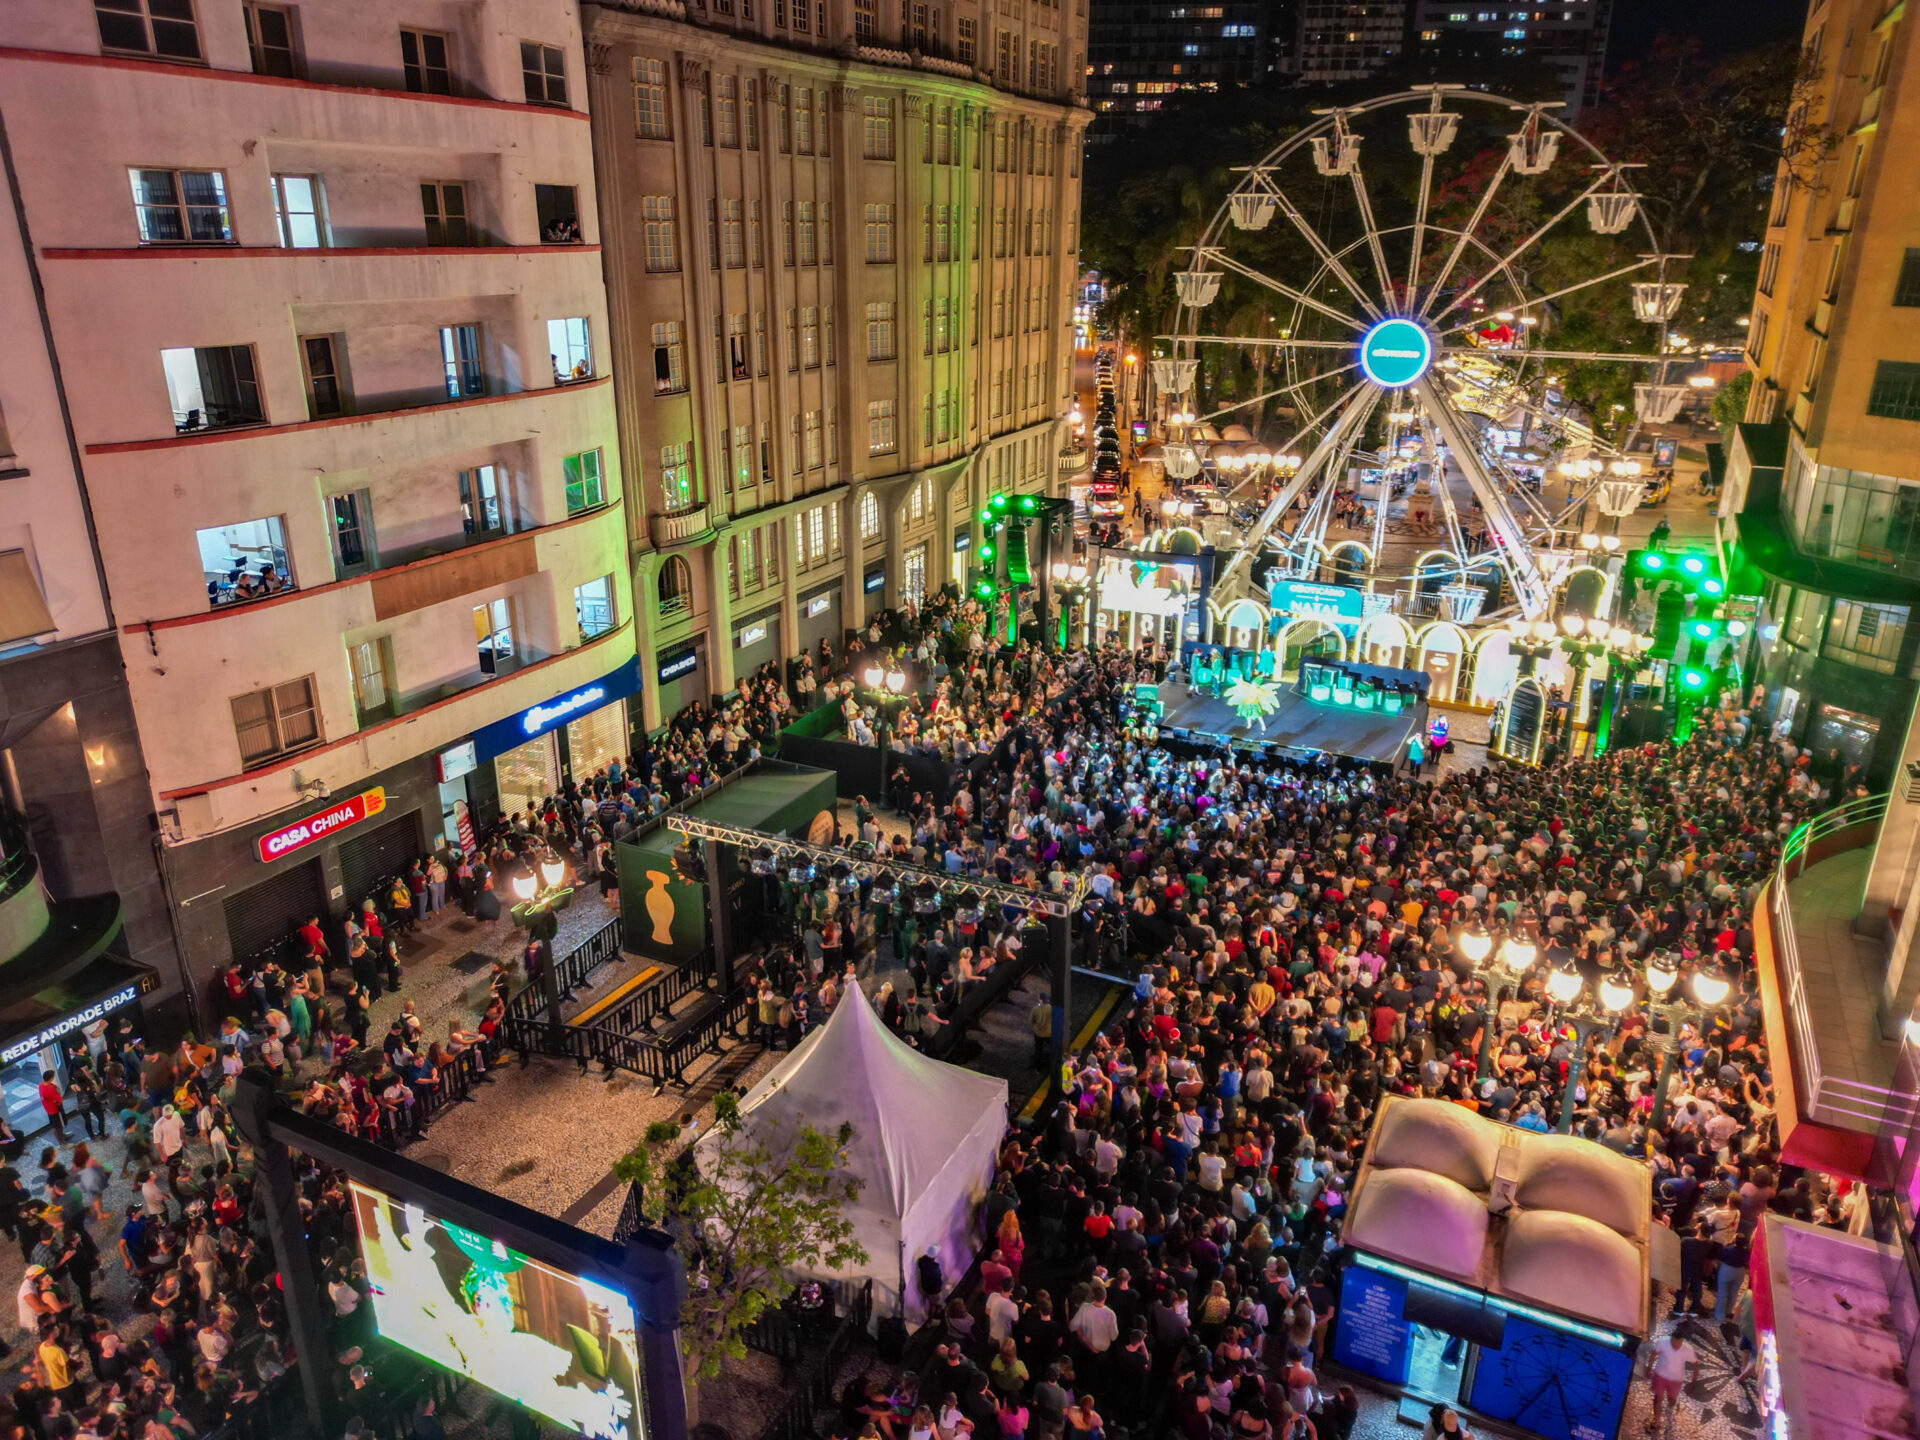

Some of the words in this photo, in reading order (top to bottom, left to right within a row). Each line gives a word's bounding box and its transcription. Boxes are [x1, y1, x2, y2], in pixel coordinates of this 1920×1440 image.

[268, 825, 311, 853] CASA
[311, 806, 355, 834] CHINA
[2, 1035, 40, 1063] REDE
[40, 1004, 104, 1044] ANDRADE
[103, 987, 136, 1011] BRAZ
